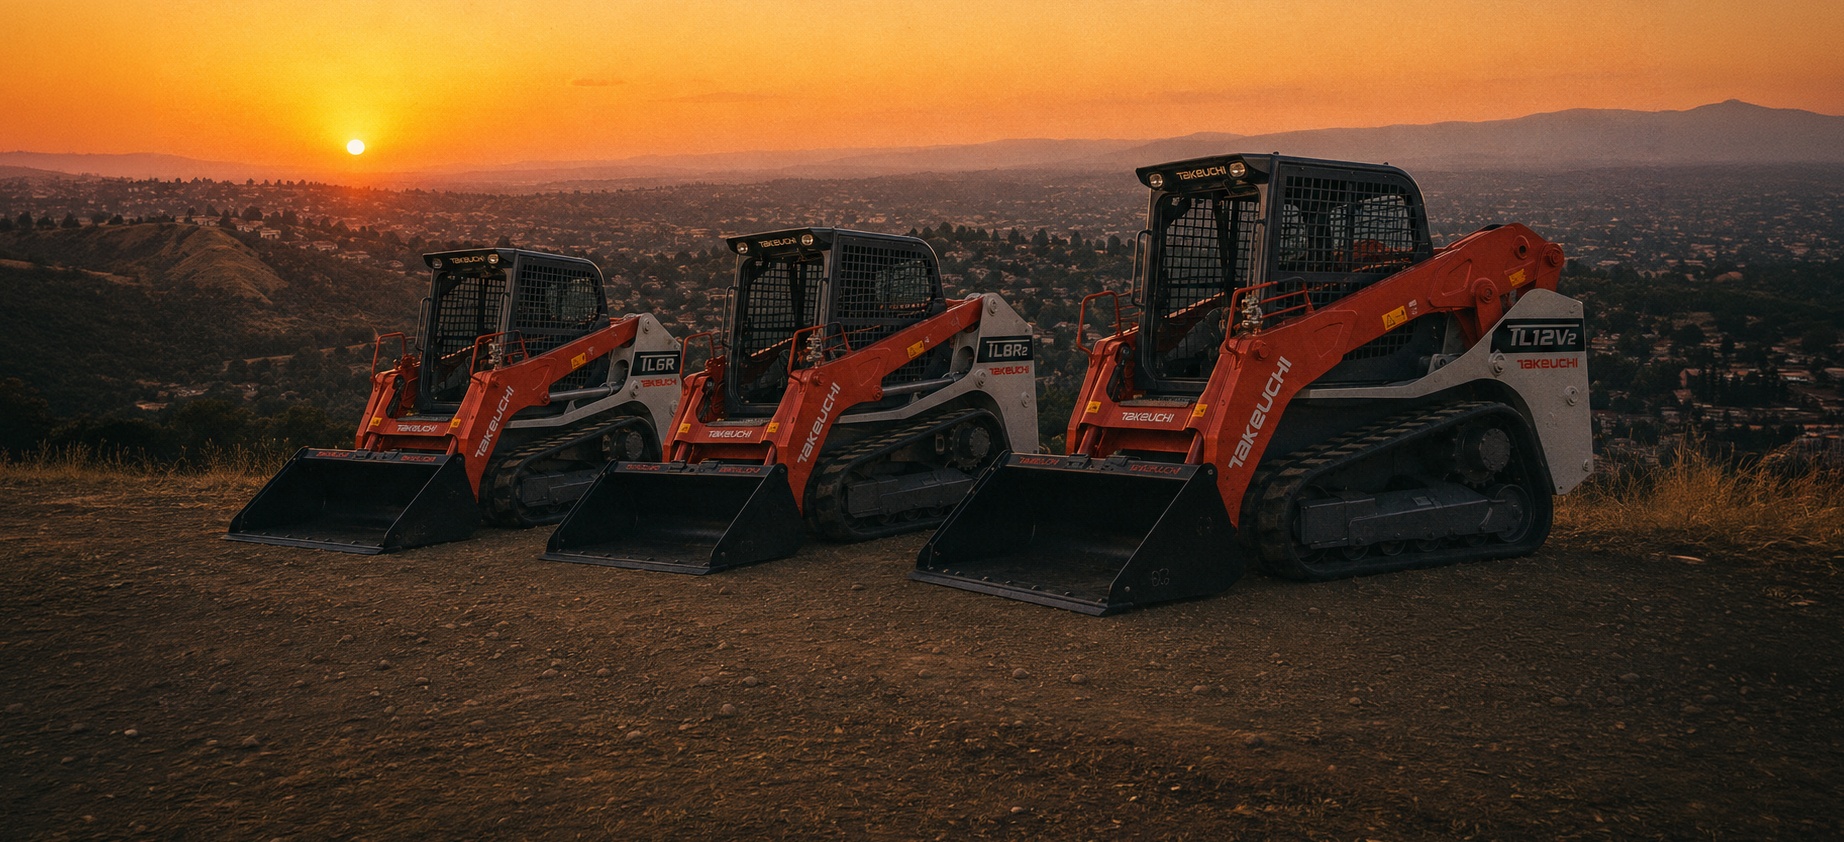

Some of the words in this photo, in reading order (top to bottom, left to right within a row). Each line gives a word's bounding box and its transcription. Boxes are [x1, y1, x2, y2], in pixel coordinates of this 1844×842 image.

[1176, 165, 1227, 181] TAKEUCHI
[1509, 326, 1577, 347] TL12V2
[641, 356, 675, 372] TL6R
[1516, 357, 1579, 370] TAKEUCHI
[1121, 412, 1175, 423] TAKEUCHI
[1227, 355, 1293, 469] TAKEUCHI
[474, 385, 515, 458] TAKEUCHI
[796, 381, 841, 463] TAKEUCHI
